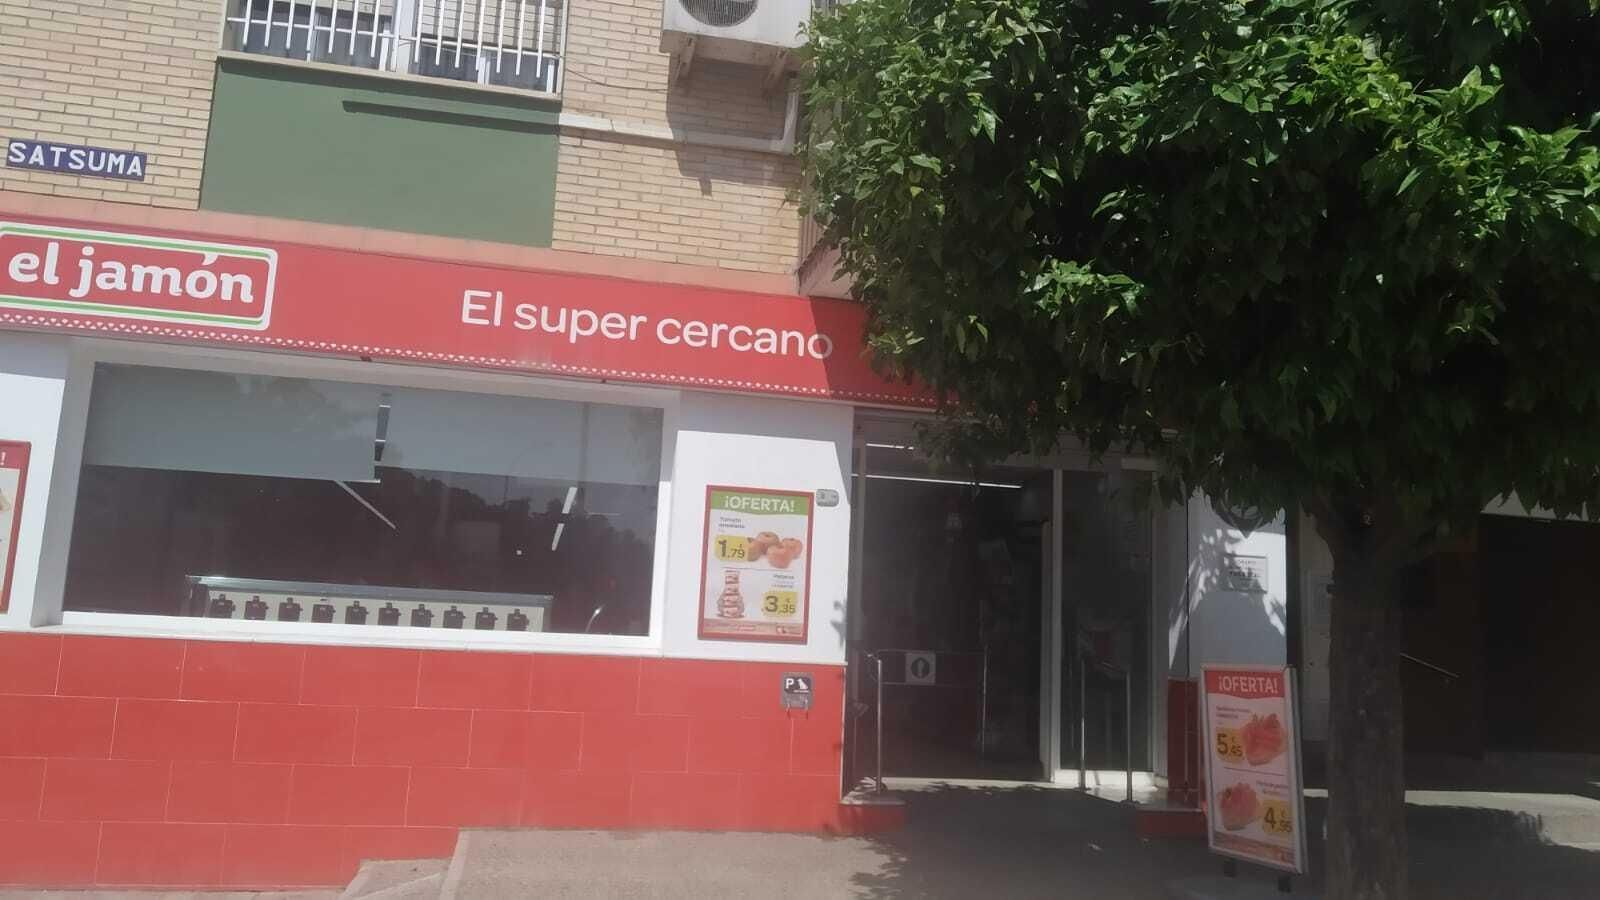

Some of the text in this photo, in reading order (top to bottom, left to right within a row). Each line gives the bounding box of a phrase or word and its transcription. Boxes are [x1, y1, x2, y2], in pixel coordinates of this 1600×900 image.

[8, 142, 143, 176] SATSUMA
[8, 241, 254, 303] el jamón
[461, 289, 833, 360] El super cercano
[724, 495, 795, 513] ¡OFERTA!
[785, 678, 795, 689] P
[1217, 675, 1279, 694] ¡OFERTA!
